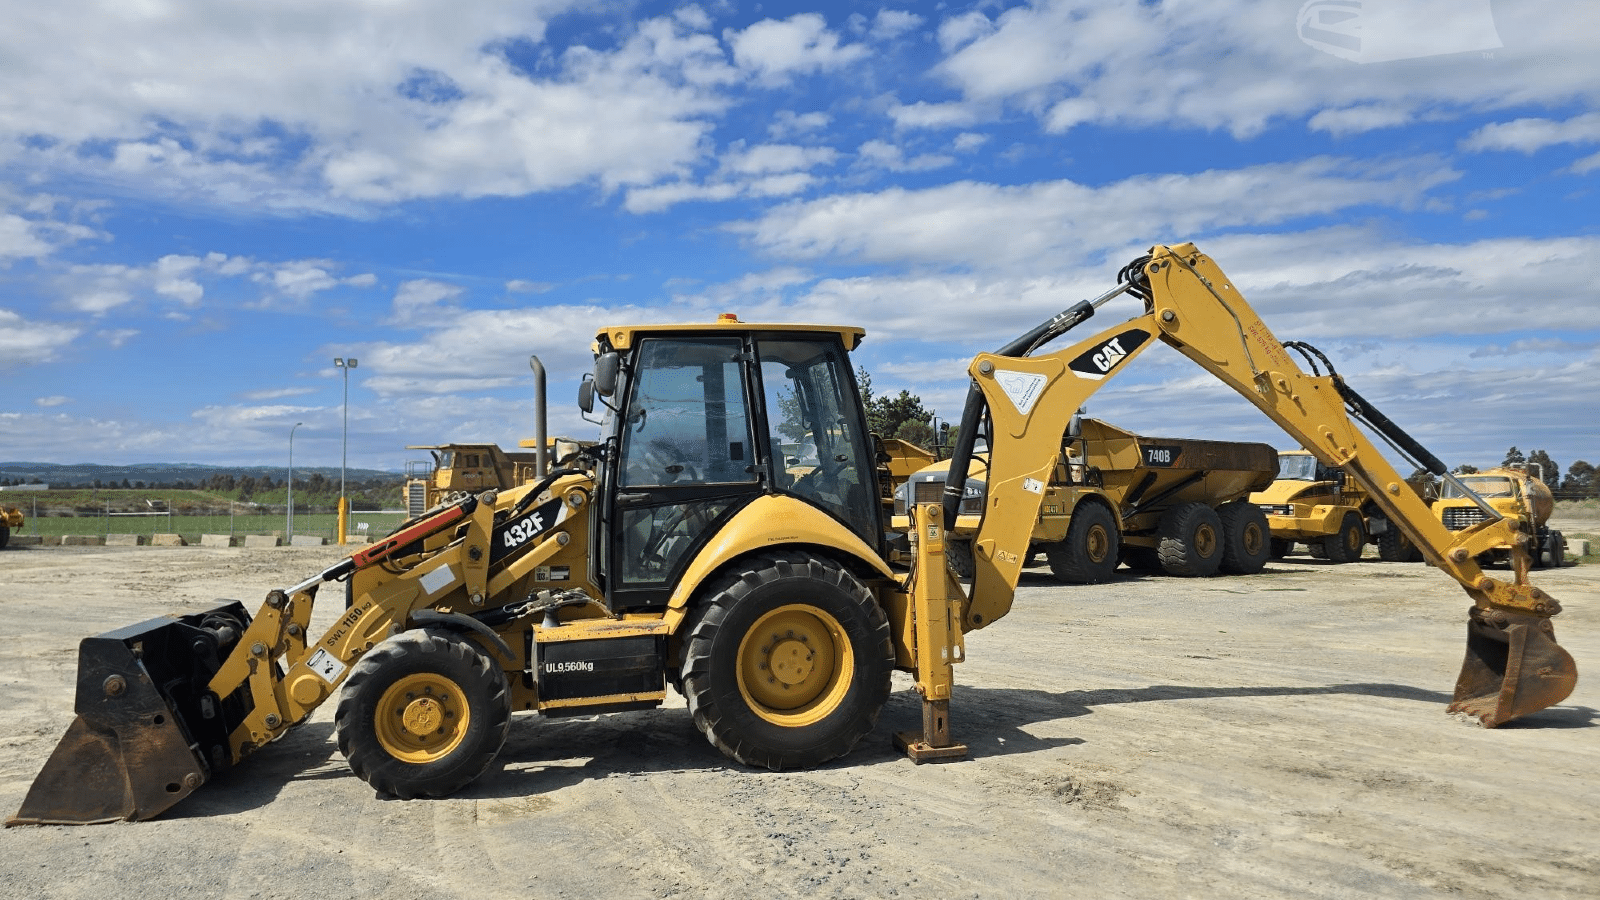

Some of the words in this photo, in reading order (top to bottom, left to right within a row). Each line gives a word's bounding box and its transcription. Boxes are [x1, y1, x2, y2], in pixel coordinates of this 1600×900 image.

[1092, 337, 1127, 372] CAT
[1148, 450, 1171, 463] 740B
[503, 511, 544, 548] 432F
[327, 629, 346, 647] SWL
[342, 607, 363, 628] 1150
